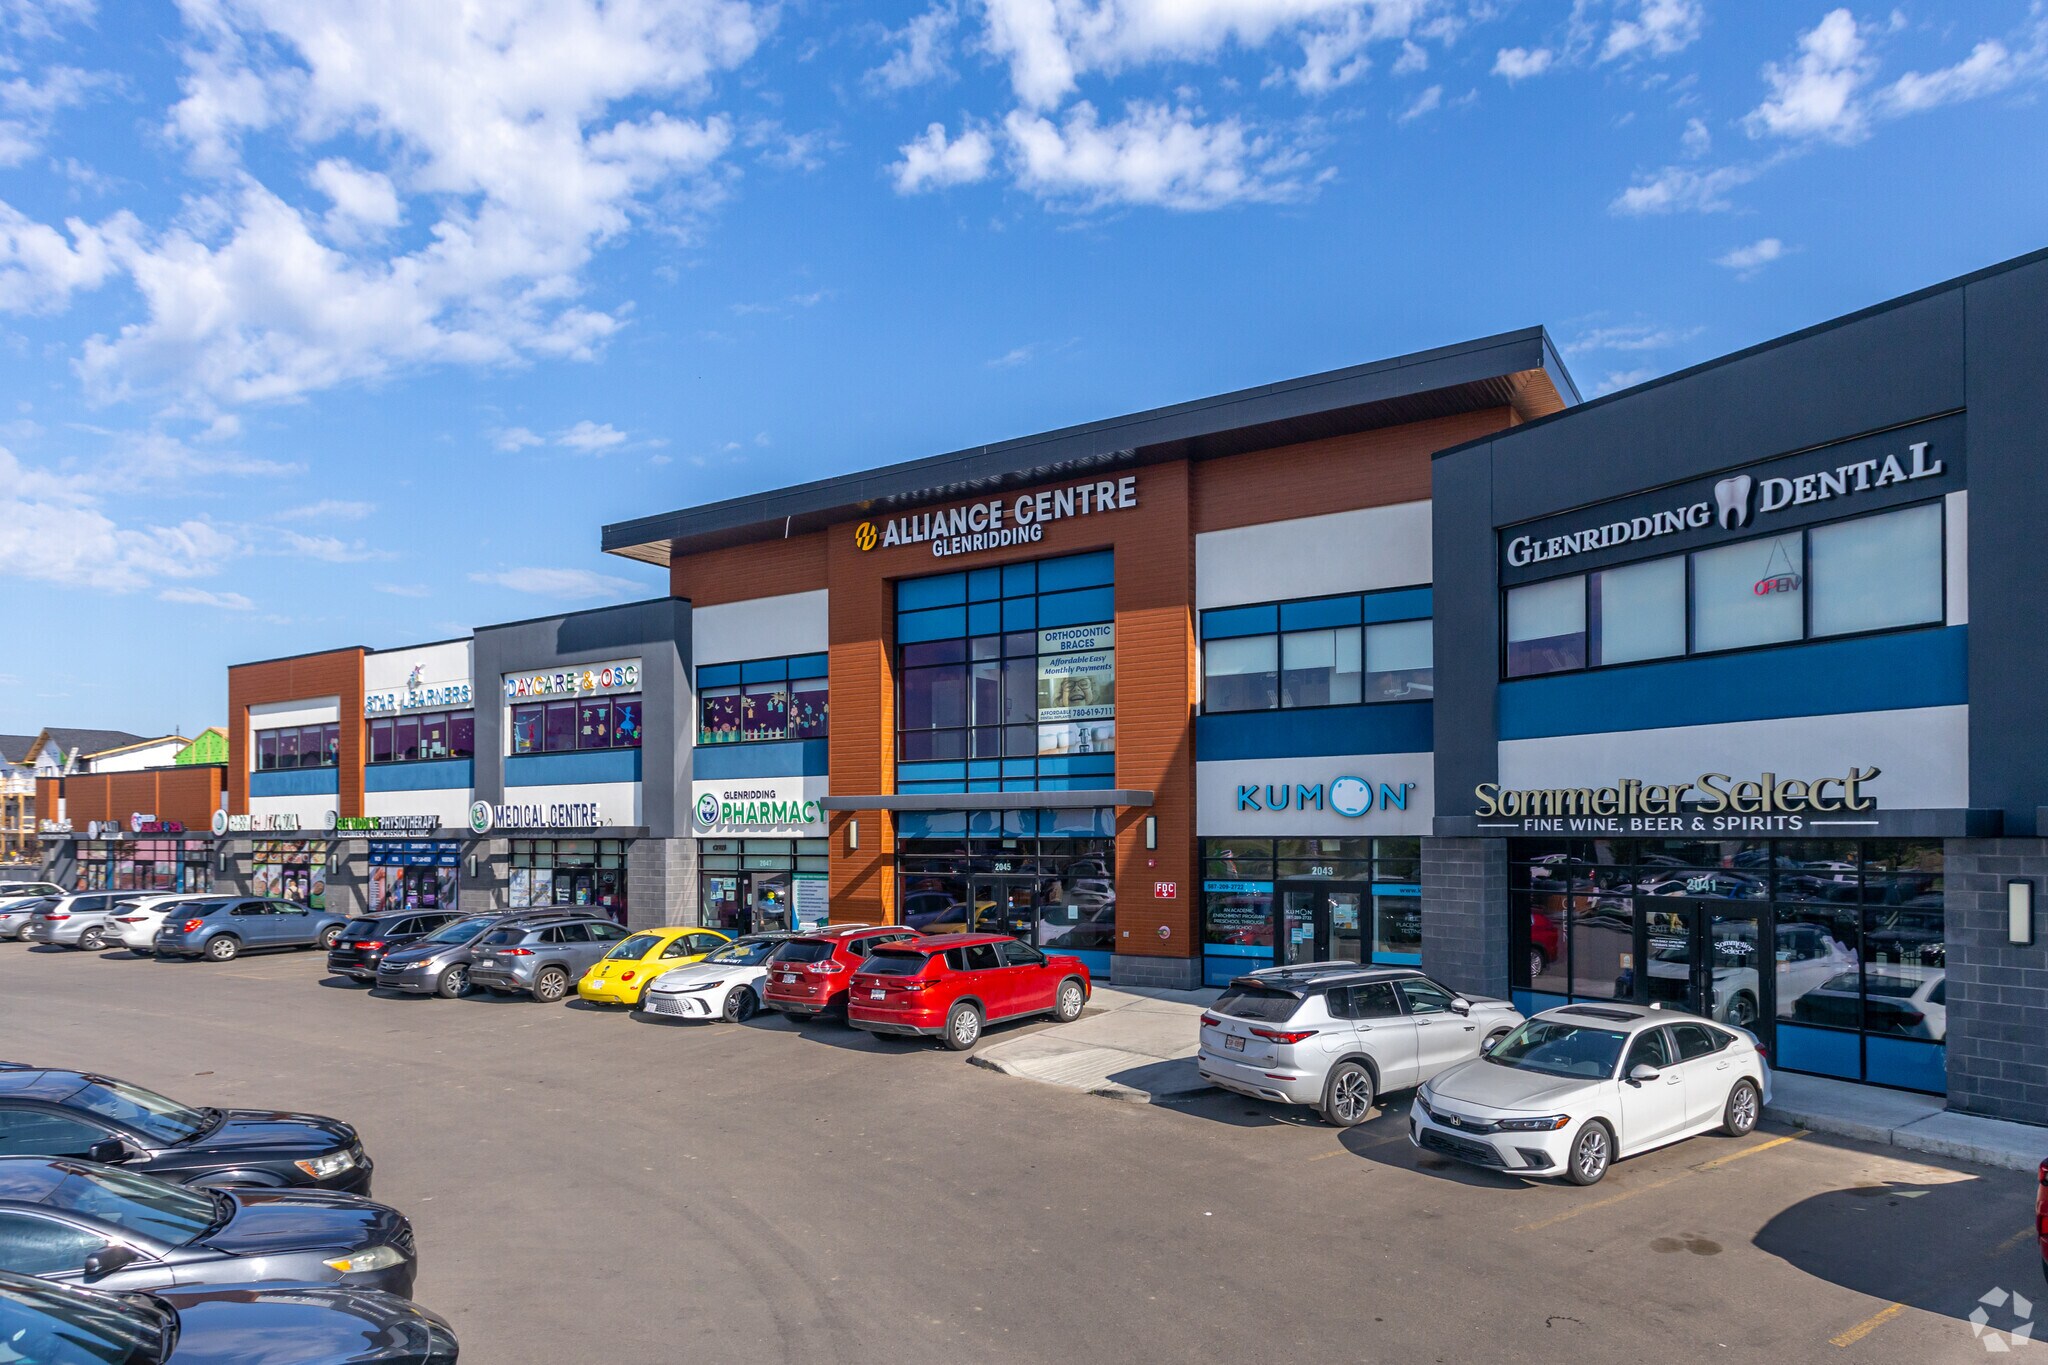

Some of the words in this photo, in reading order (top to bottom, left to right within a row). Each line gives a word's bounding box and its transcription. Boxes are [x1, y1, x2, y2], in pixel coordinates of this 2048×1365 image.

[882, 500, 1003, 547] ALLIANCE
[1014, 476, 1137, 525] CENTRE
[1507, 502, 1711, 567] GLENRIDDING
[1760, 441, 1943, 512] DENTAL
[932, 523, 1043, 557] GLENRIDDING
[1753, 576, 1800, 597] OPEN
[1045, 626, 1111, 641] ORTHODONTIC
[1061, 638, 1095, 650] BRACES
[1045, 665, 1075, 675] Monthly
[1075, 663, 1112, 673] Payments
[1050, 656, 1089, 667] Affordable
[1089, 655, 1107, 664] Easy
[508, 673, 575, 697] DAYCARE
[582, 671, 595, 690] &
[601, 666, 637, 688] OSC
[366, 694, 396, 713] STAR
[402, 685, 471, 709] LEARNERS
[723, 789, 776, 800] GLENRIDDING
[1237, 775, 1408, 818] KUMON
[1475, 778, 1694, 817] Sommelier
[1696, 766, 1882, 813] Select
[495, 805, 547, 827] MEDICAL
[550, 803, 599, 827] CENTRE
[721, 800, 827, 824] PHARMACY
[380, 815, 438, 829] PHYSIOTHERAPY
[1523, 818, 1564, 831] FINE
[1568, 818, 1624, 833] WINE,
[1630, 817, 1684, 831] BEER
[1690, 817, 1706, 831] &
[1712, 815, 1804, 831] SPIRITS
[995, 863, 1012, 871] 2045
[1311, 866, 1334, 876] 2043
[1156, 883, 1174, 893] FDC
[1686, 878, 1717, 892] 2041
[1285, 908, 1313, 916] KUMON
